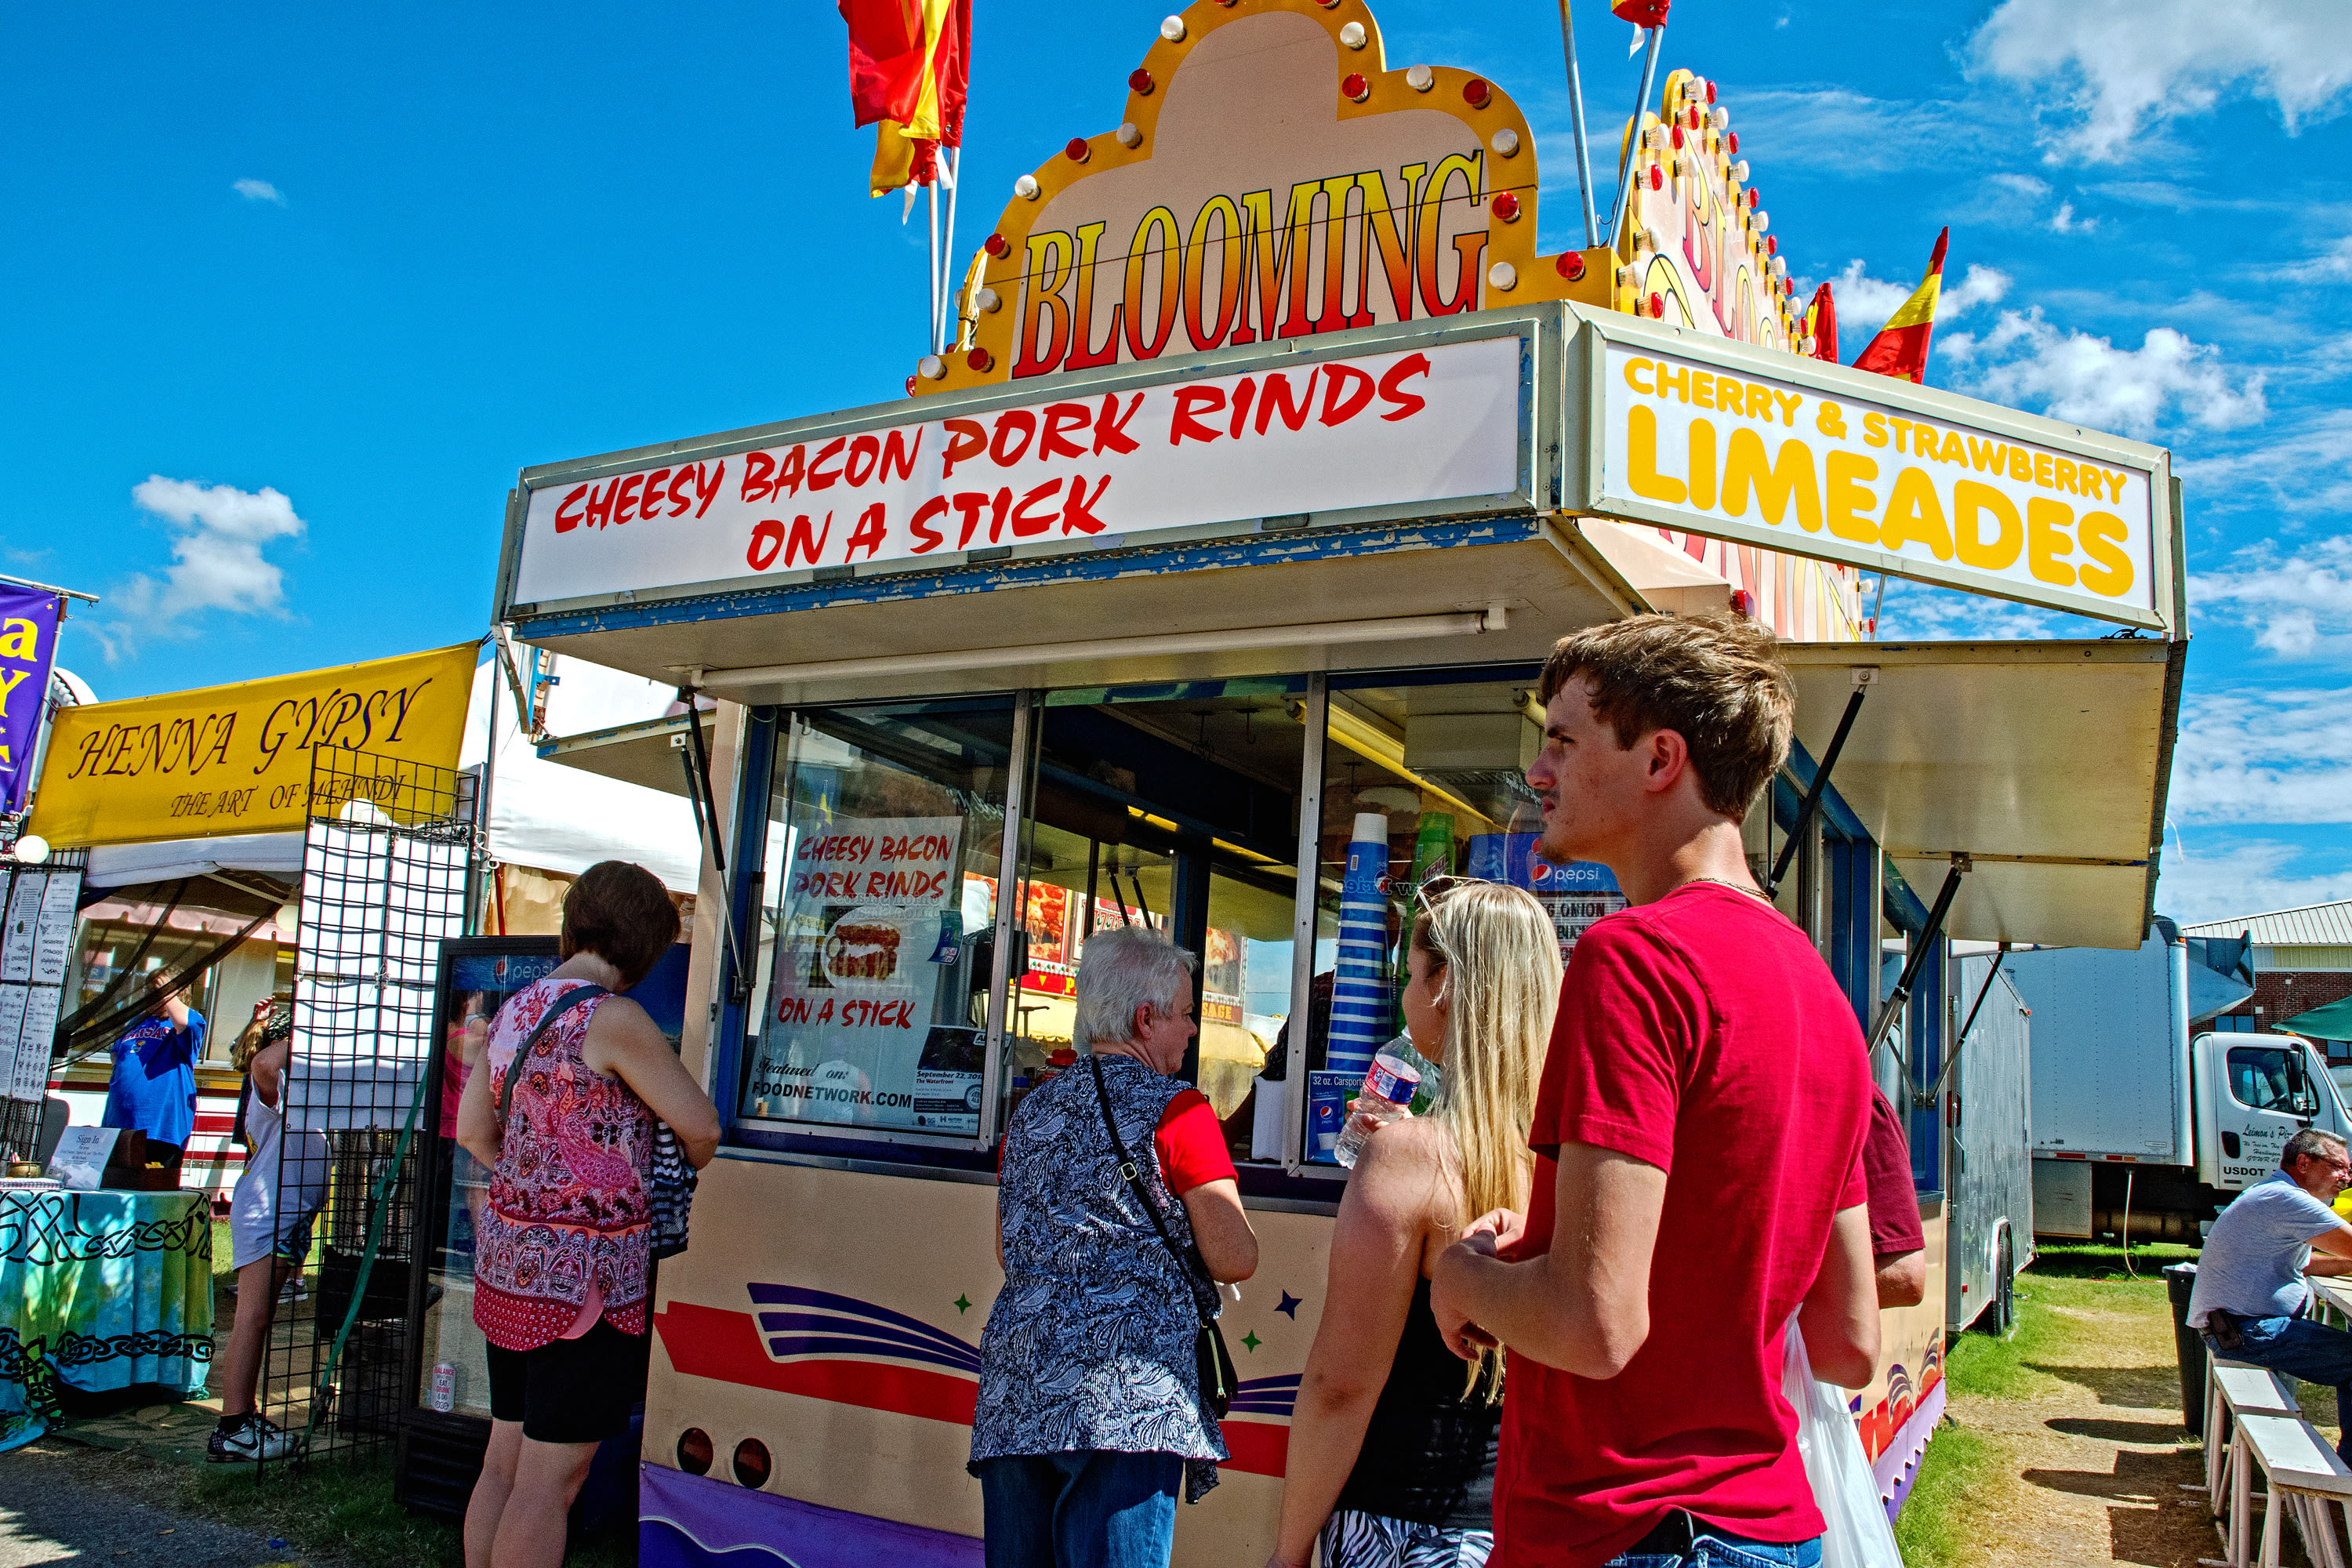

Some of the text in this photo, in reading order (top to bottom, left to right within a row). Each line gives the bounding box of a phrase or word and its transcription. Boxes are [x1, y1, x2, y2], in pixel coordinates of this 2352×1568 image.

[1011, 149, 1489, 380] BLOOMING
[554, 352, 1432, 534] CHEESY BACON PORK RINDS
[1624, 357, 2128, 505] CHERRY & STRAWBERRY
[1627, 404, 2135, 597] LIMEADES
[746, 474, 1112, 572] ON A STICK
[68, 677, 433, 779] HENNA GYPSY
[169, 774, 407, 818] THE ART OF MEHNDI
[797, 834, 956, 865] CHEESY BACON
[791, 869, 949, 900] PORK RINDS
[1555, 867, 1599, 883] pepsi
[1560, 902, 1605, 917] ONION
[512, 961, 554, 983] pepsi
[778, 997, 916, 1030] ON A STICK
[754, 1057, 820, 1078] Featured
[916, 1070, 955, 1079] September
[1312, 1076, 1322, 1085] 32
[1323, 1077, 1333, 1086] oz.
[751, 1080, 913, 1109] FOODNETWORK.COM
[76, 1134, 100, 1145] Sign In
[2223, 1166, 2266, 1177] USDOT
